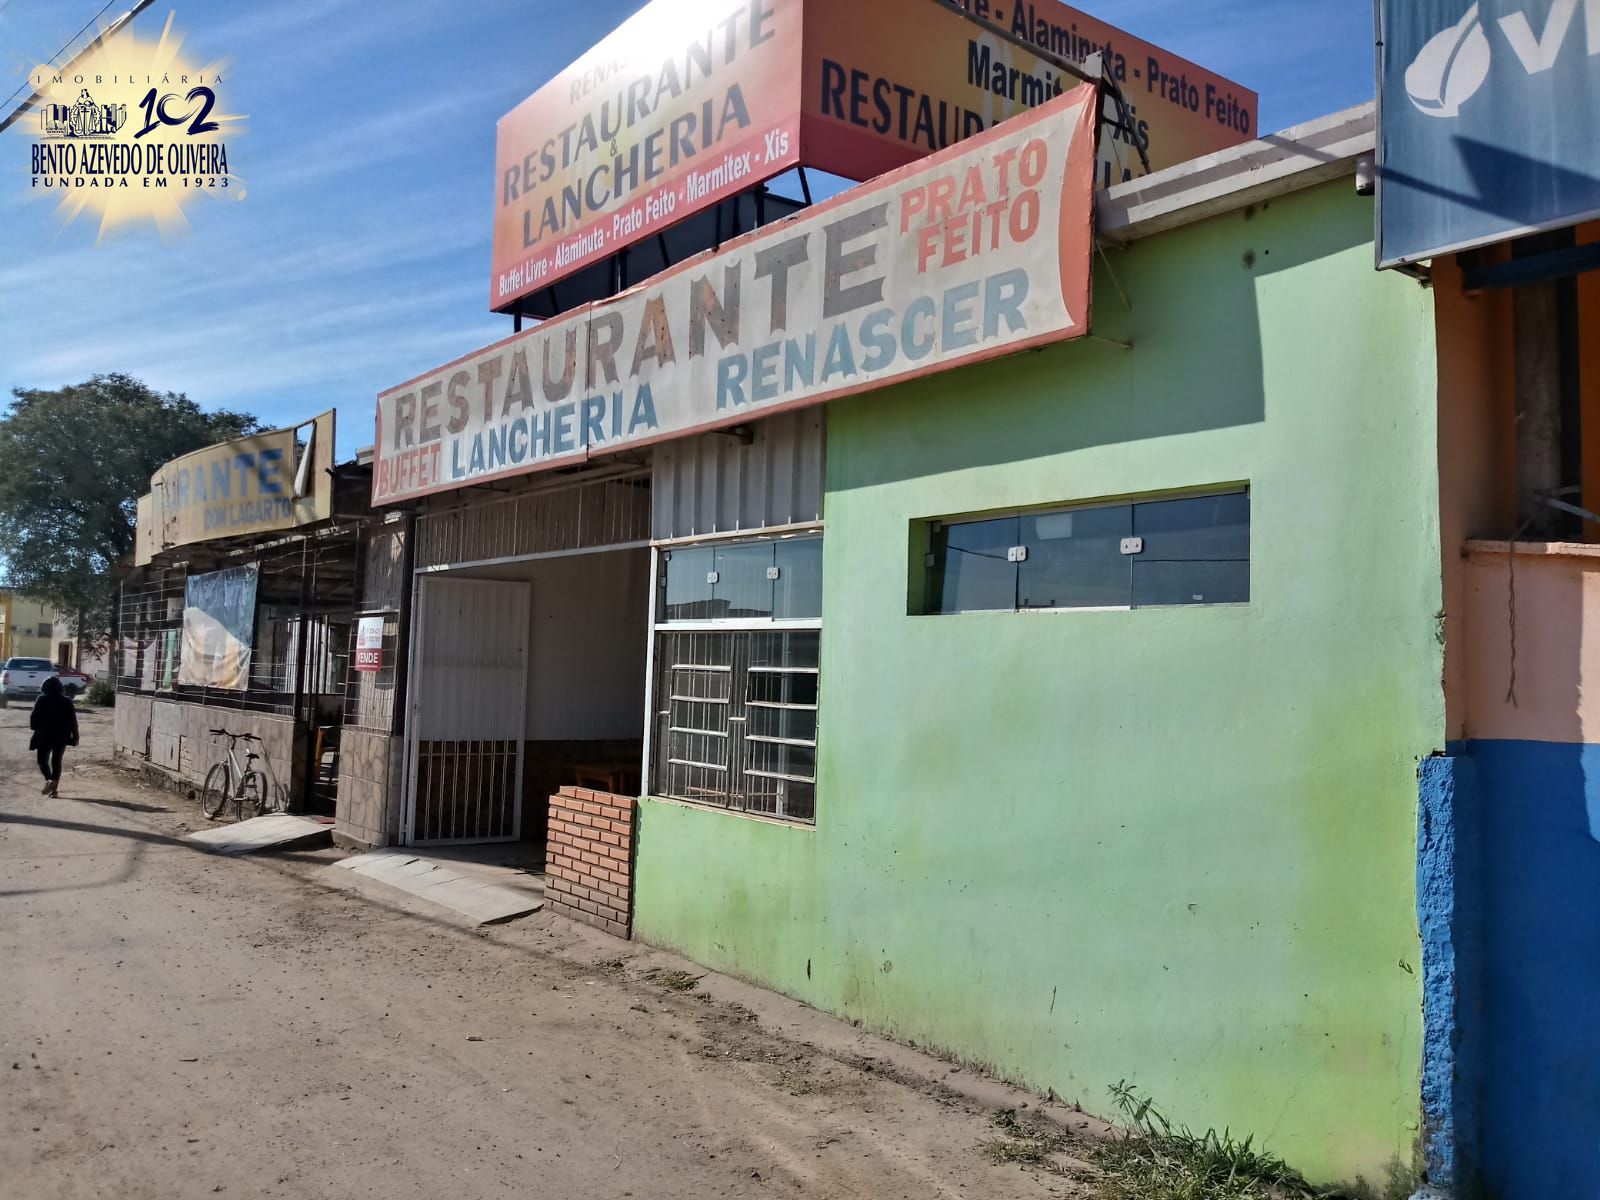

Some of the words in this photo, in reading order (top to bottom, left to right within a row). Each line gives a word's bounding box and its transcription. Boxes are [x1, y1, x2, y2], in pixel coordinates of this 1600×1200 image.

[503, 0, 776, 207] RESTAURANTE
[968, 39, 1064, 107] Marmit
[1148, 56, 1199, 112] Prato
[1206, 83, 1249, 134] Feito
[523, 82, 751, 249] LANCHERIA
[609, 136, 618, 157] &
[902, 138, 1048, 234] PRATO
[499, 267, 523, 297] Buffet
[525, 259, 547, 284] Livre
[555, 234, 604, 270] Alaminuta
[613, 212, 642, 240] Prato
[645, 190, 675, 225] Feito
[687, 150, 751, 203] Marmitex
[764, 128, 789, 165] Xis
[918, 188, 1040, 275] FEITO
[378, 443, 442, 498] BUFFET
[452, 382, 659, 480] LANCHERIA
[717, 267, 1030, 411] RENASCER
[394, 202, 889, 451] RESTAURANTE
